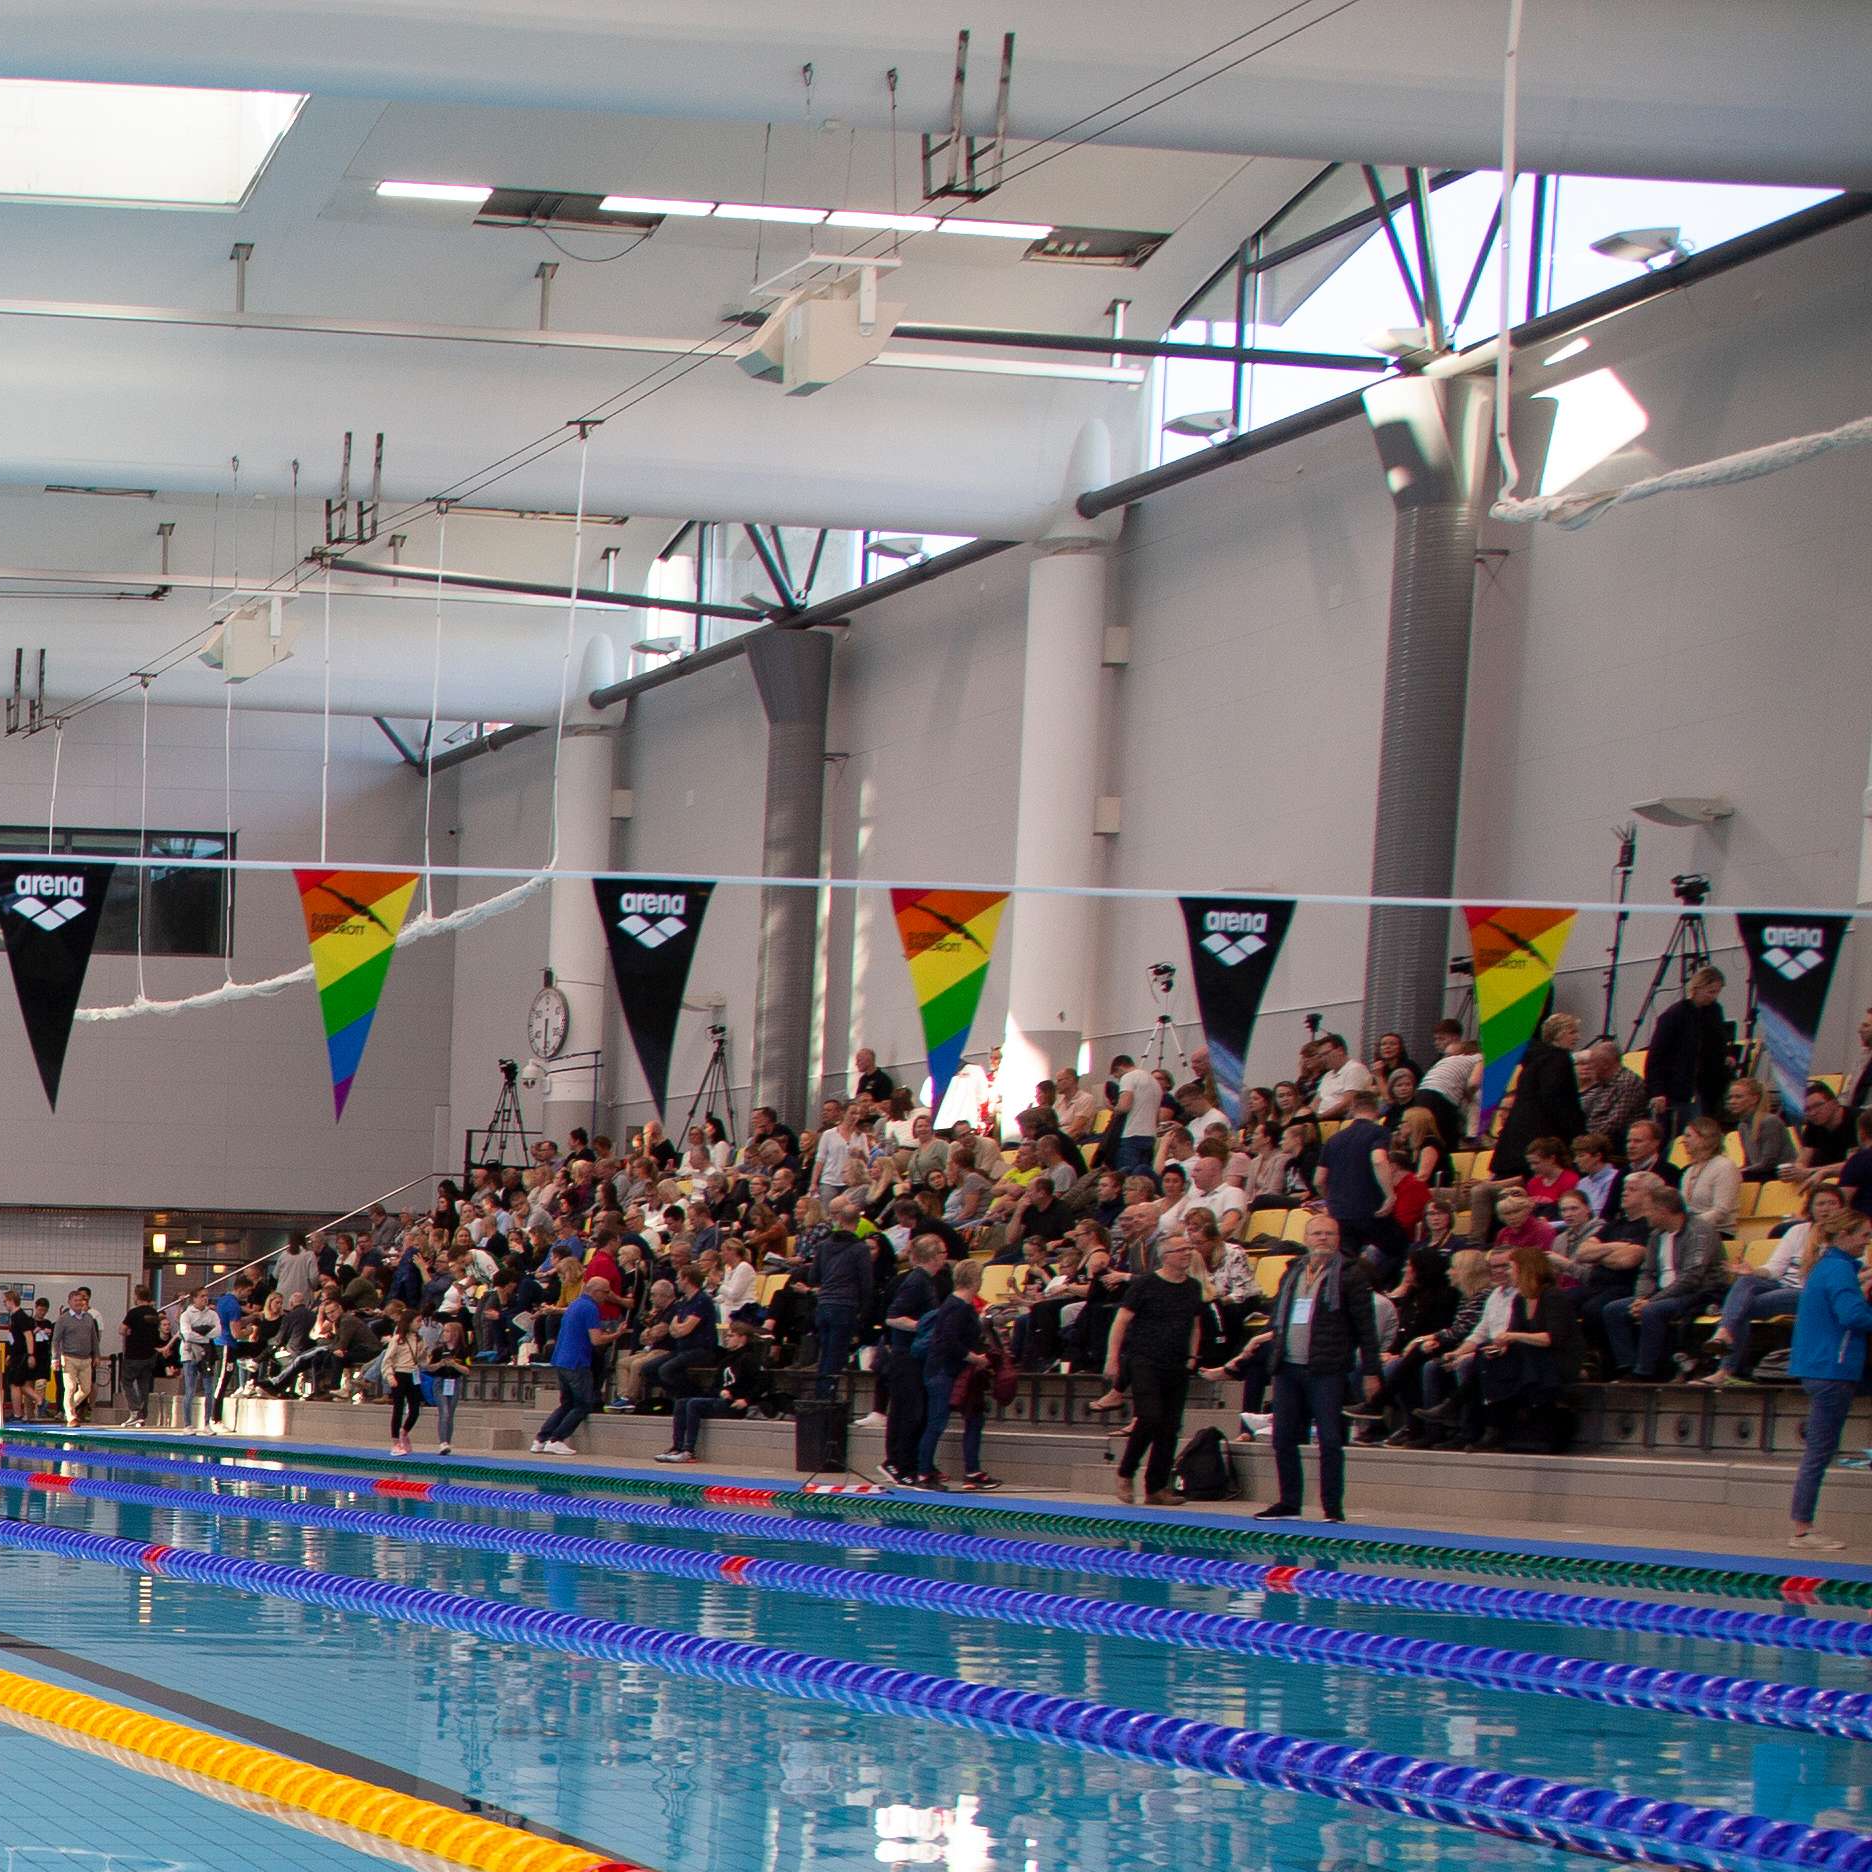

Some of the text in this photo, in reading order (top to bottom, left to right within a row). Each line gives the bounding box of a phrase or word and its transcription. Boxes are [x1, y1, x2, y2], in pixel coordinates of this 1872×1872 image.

[15, 874, 84, 897] arena
[620, 893, 686, 915] arena
[1204, 911, 1267, 933] arena
[1763, 927, 1823, 948] arena
